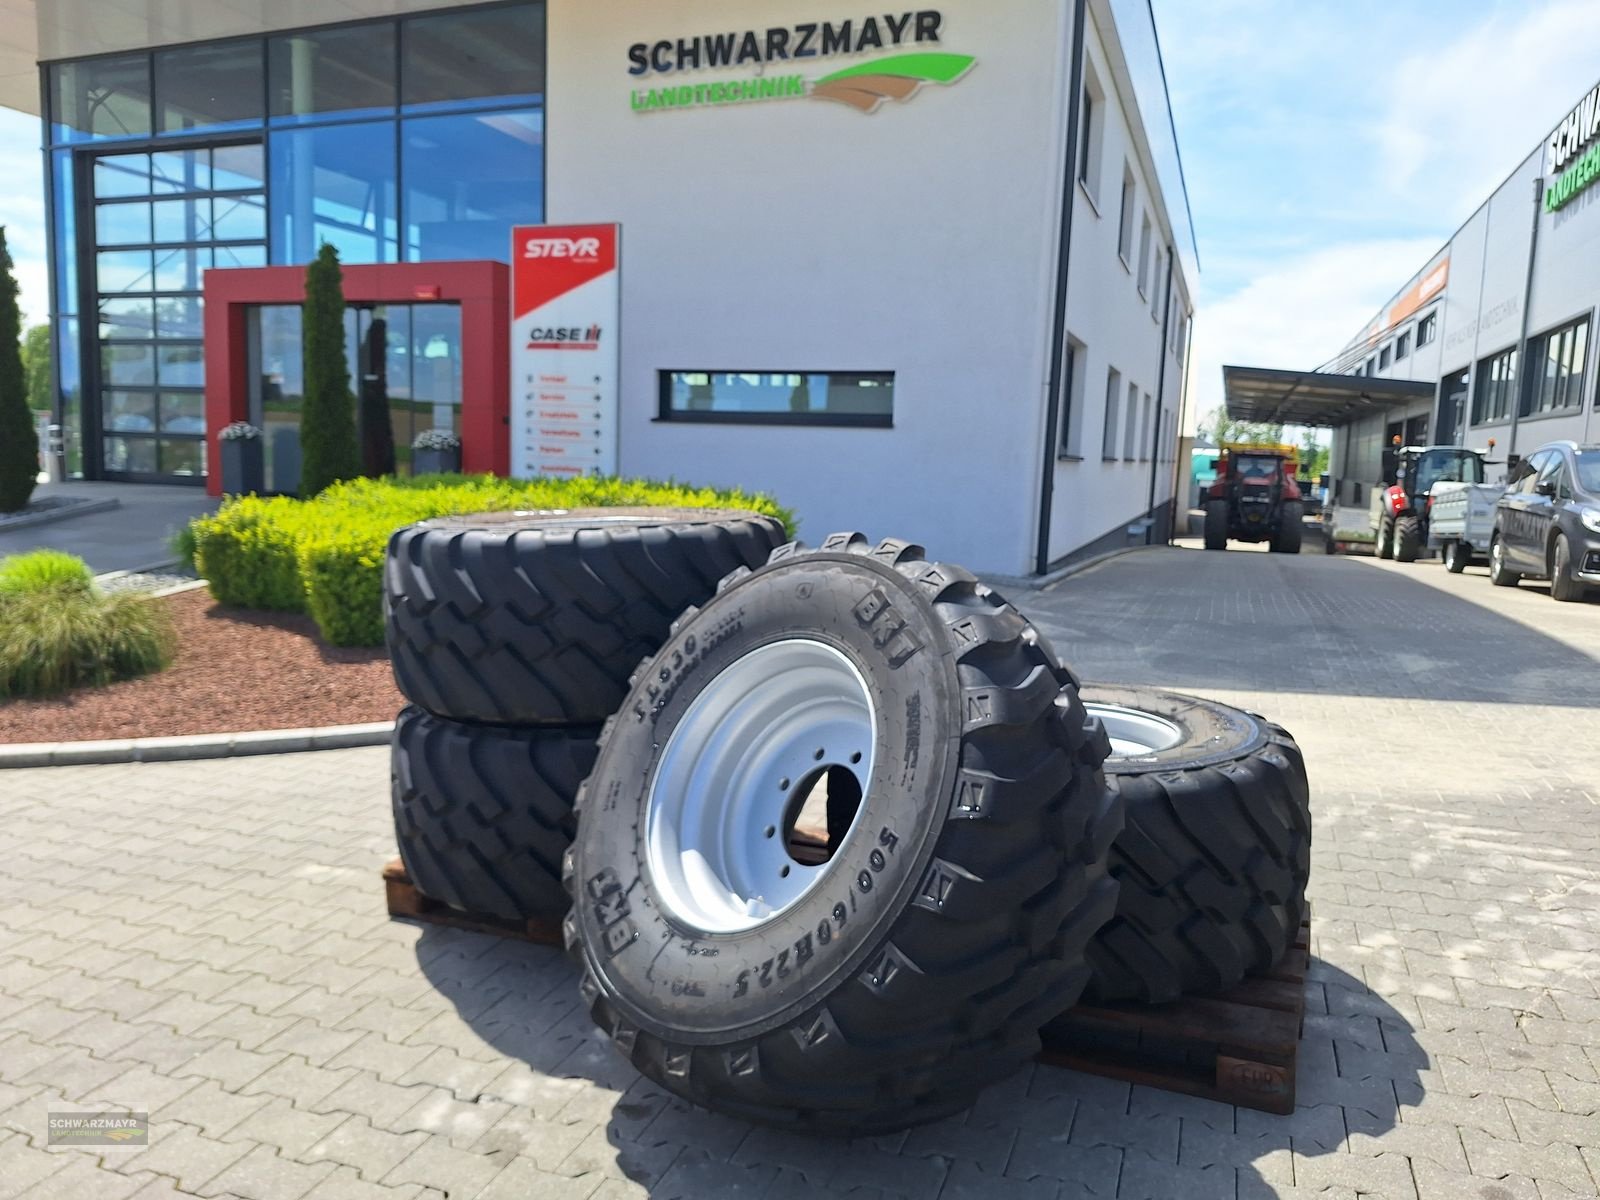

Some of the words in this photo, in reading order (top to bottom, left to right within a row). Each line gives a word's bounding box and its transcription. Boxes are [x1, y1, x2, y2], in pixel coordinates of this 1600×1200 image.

[628, 10, 942, 75] SCHWARZMAYR
[631, 75, 805, 111] LANDTECHNIK
[524, 237, 600, 258] STEYR
[530, 327, 581, 341] CASE
[852, 588, 925, 669] BKT
[586, 864, 640, 960] BKT
